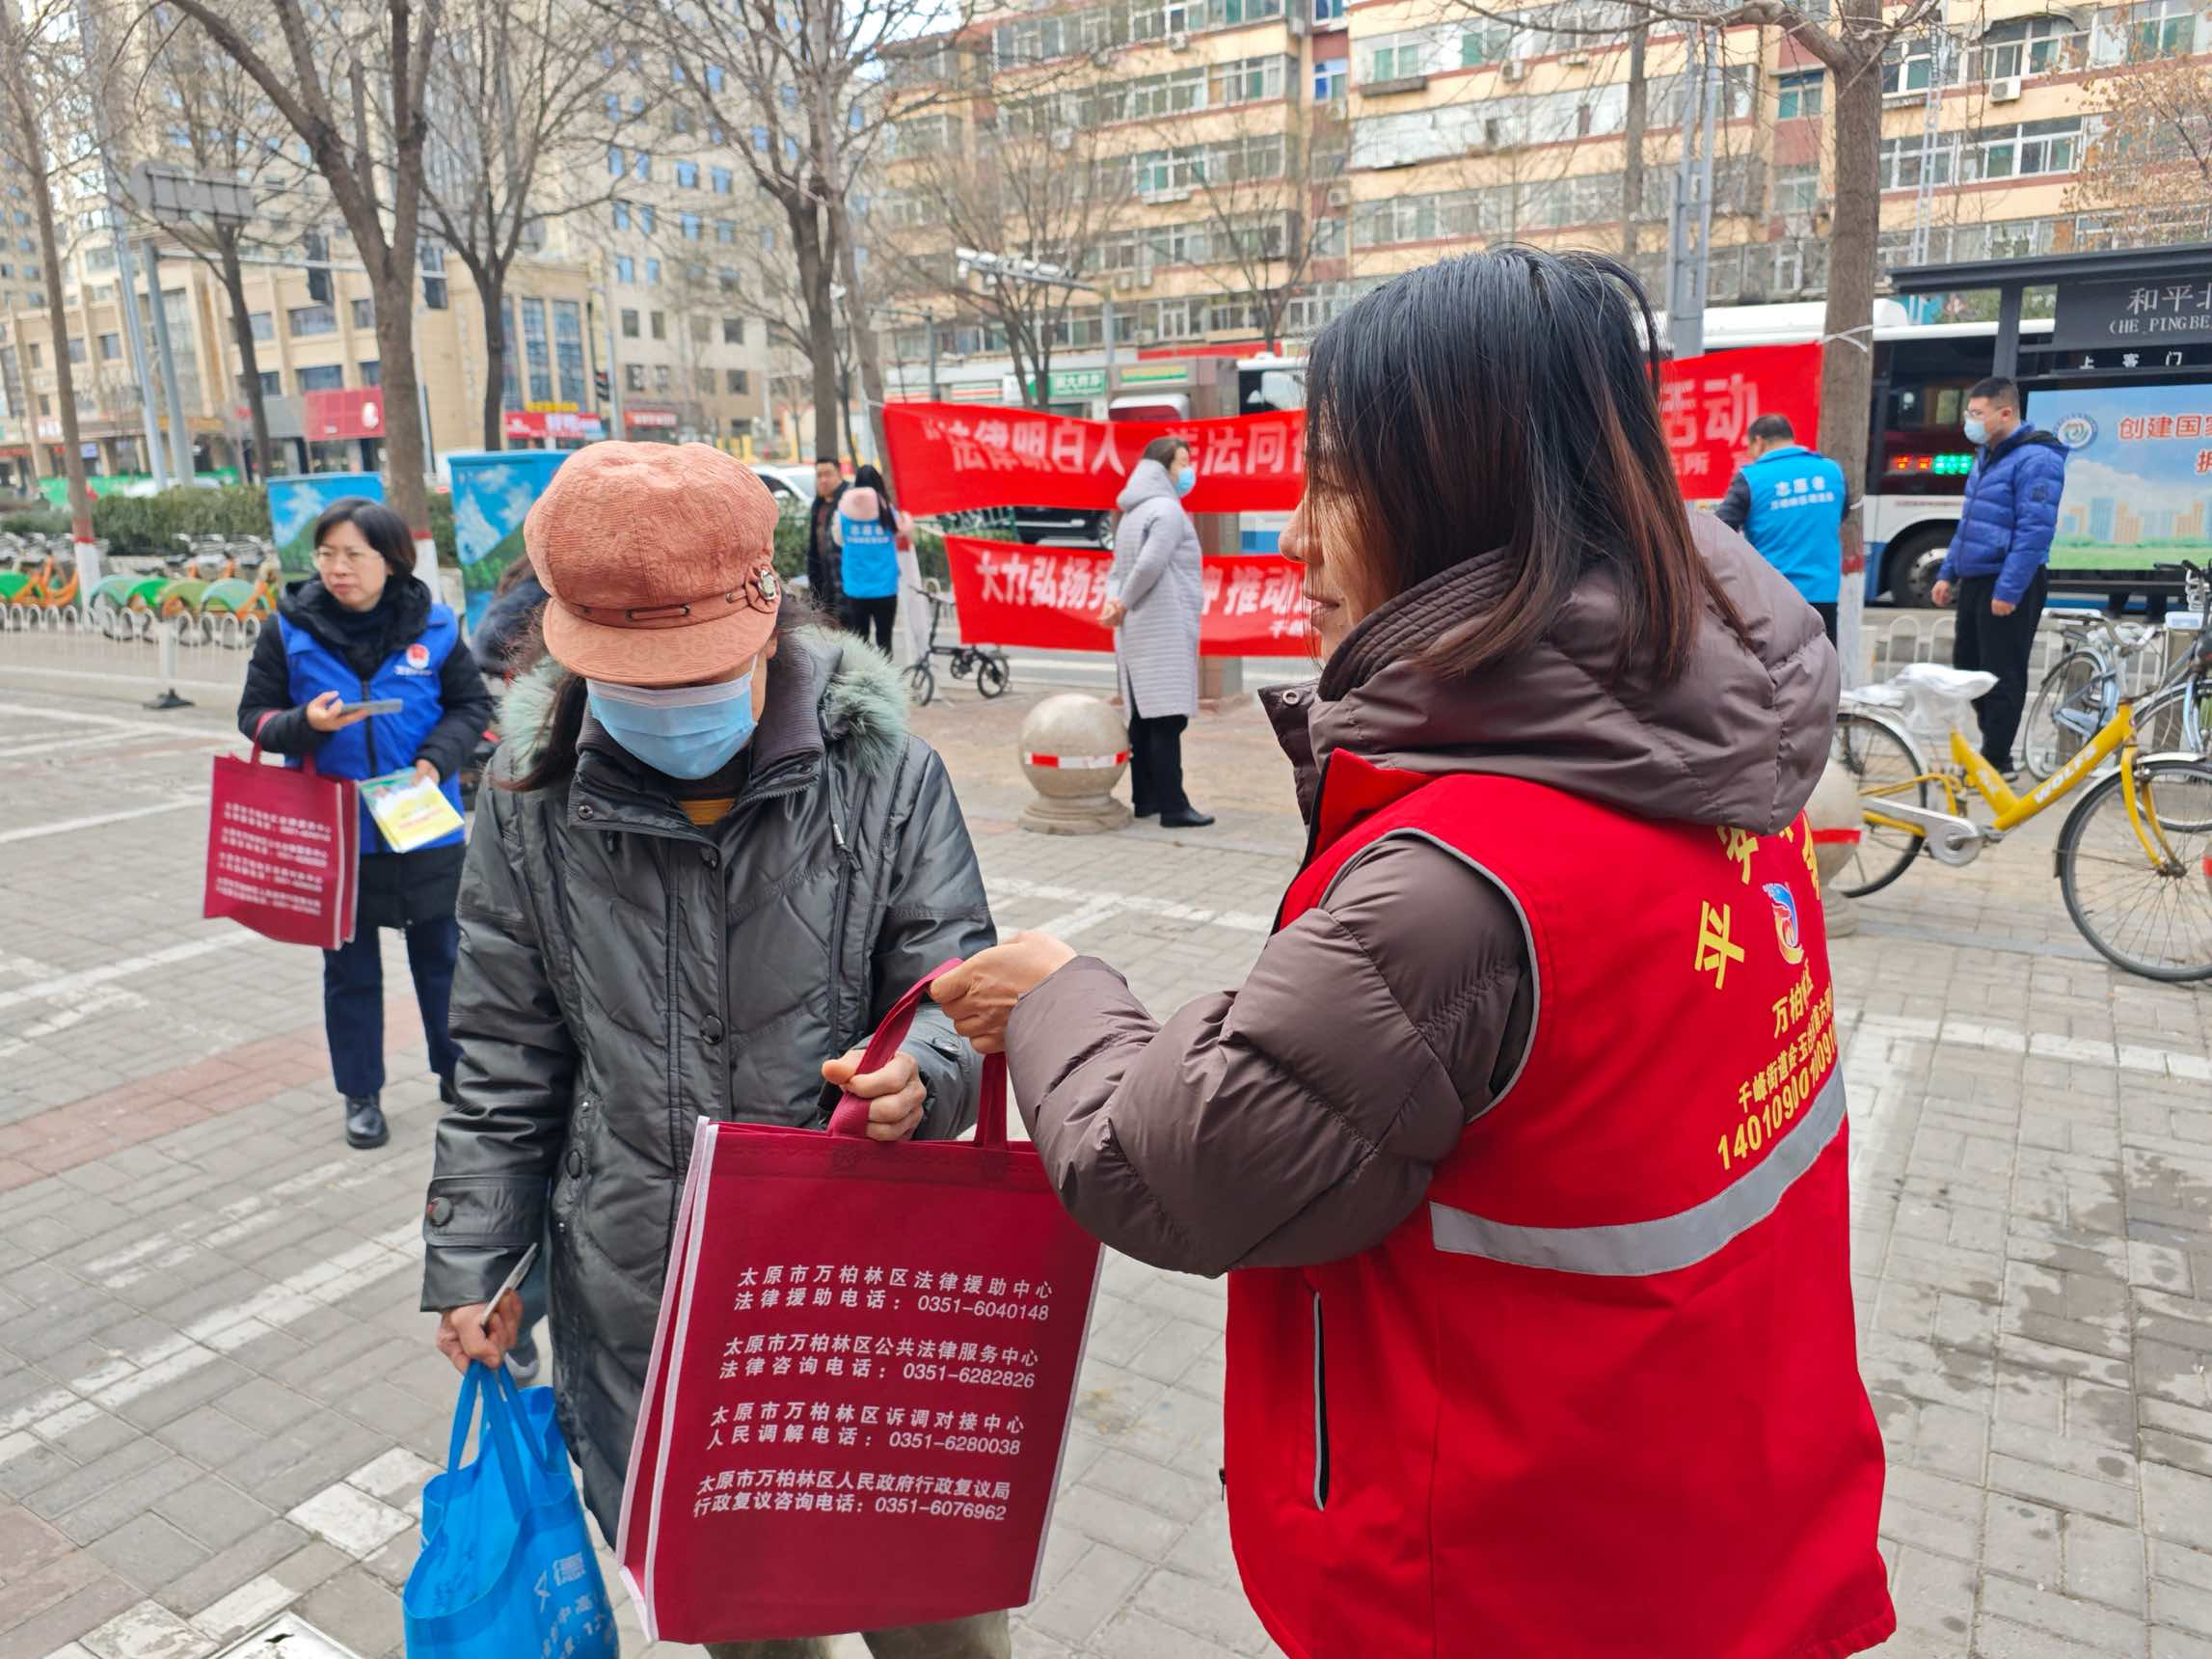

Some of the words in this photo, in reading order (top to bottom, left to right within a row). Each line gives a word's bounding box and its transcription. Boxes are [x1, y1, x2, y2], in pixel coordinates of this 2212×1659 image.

[737, 1265, 1053, 1299] 太原市万柏林区法律援助中心
[722, 1333, 1039, 1367] 太原市万柏林区公共法律服务中心
[710, 1401, 1024, 1434] 太原市万柏林区诉调对接中心
[696, 1468, 1012, 1501] 太原市万柏林区人民政府行政复议局
